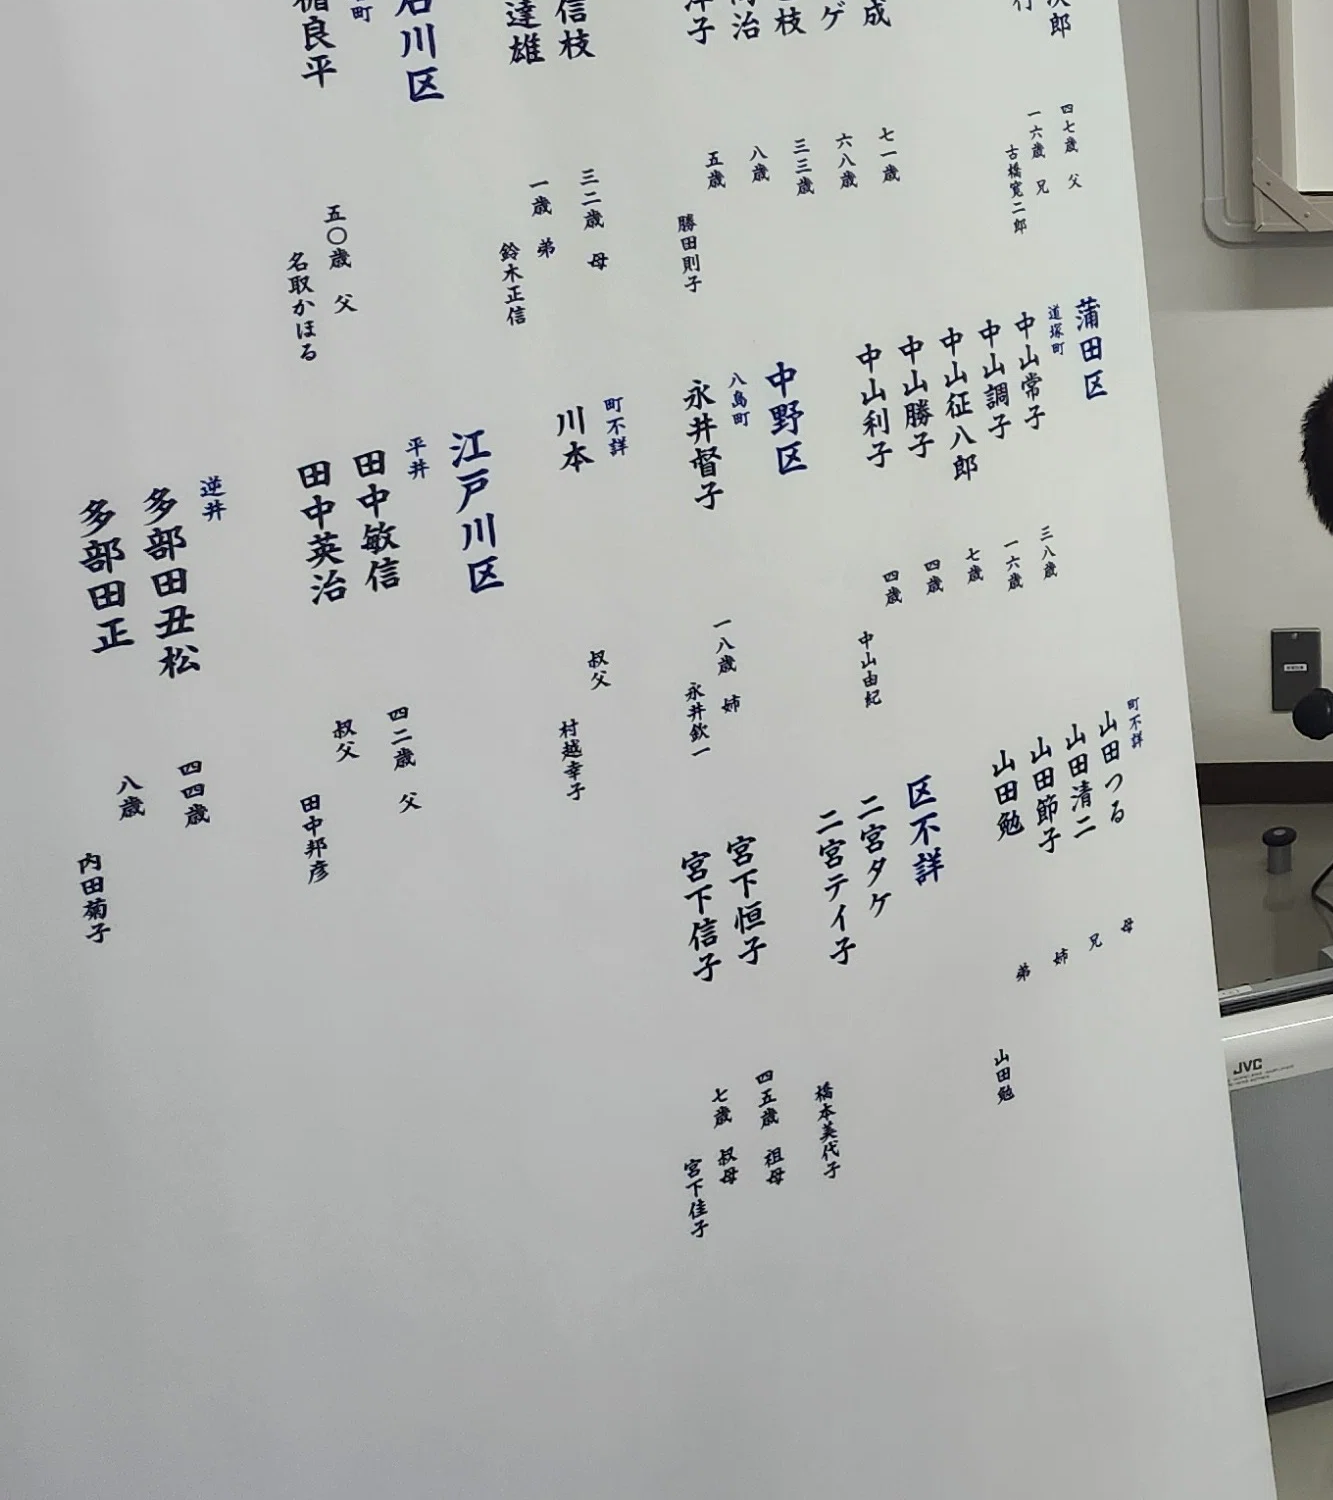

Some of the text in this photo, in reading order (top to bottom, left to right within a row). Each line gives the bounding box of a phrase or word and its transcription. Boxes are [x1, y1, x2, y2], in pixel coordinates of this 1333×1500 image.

[580, 169, 604, 231] 三二歳
[879, 127, 900, 183] 七一歳
[286, 252, 317, 361] 名取かほる
[499, 242, 526, 326] 鈴木正信
[677, 214, 702, 293] 勝田則子
[728, 372, 750, 427] 八島町
[898, 335, 935, 458] 中山勝子
[978, 319, 1011, 439] 中山調子
[1014, 311, 1045, 430] 中山常子
[1075, 296, 1108, 400] 蒲田区
[557, 406, 595, 473] 川本
[603, 397, 628, 457] 町不詳
[683, 379, 724, 510] 永井督子
[765, 361, 808, 475] 中野区
[855, 343, 893, 468] 中山利子
[939, 327, 978, 481] 中山征八郎
[200, 475, 227, 522] 逆井
[405, 436, 430, 480] 平井
[296, 461, 347, 605] 田中英治
[352, 450, 400, 592] 田中敏信
[449, 429, 504, 594] 江戸川区
[79, 499, 135, 653] 多部田正
[143, 487, 200, 679] 多部田丑松
[858, 631, 882, 708] 中山由紀
[387, 706, 416, 771] 四二歳
[559, 718, 586, 801] 村越幸子
[1099, 710, 1124, 823] 山田つる
[1127, 697, 1143, 749] 町不詳
[907, 774, 944, 886] 区不詳
[992, 750, 1025, 841] 山田勉
[1030, 736, 1061, 853] 山田節子
[1065, 723, 1096, 838] 山田清二
[300, 794, 329, 884] 田中邦彦
[816, 810, 856, 965] 二宮テイ子
[857, 795, 892, 918] 二宮タケ
[77, 853, 111, 943] 内田菊子
[681, 851, 722, 982] 宮下信子
[726, 835, 767, 965] 宮下恒子
[755, 1070, 779, 1130] 四五歳
[1233, 1058, 1263, 1075] JVC
[815, 1081, 841, 1179] 橋本美代子
[684, 1159, 709, 1238] 宮下佳子
